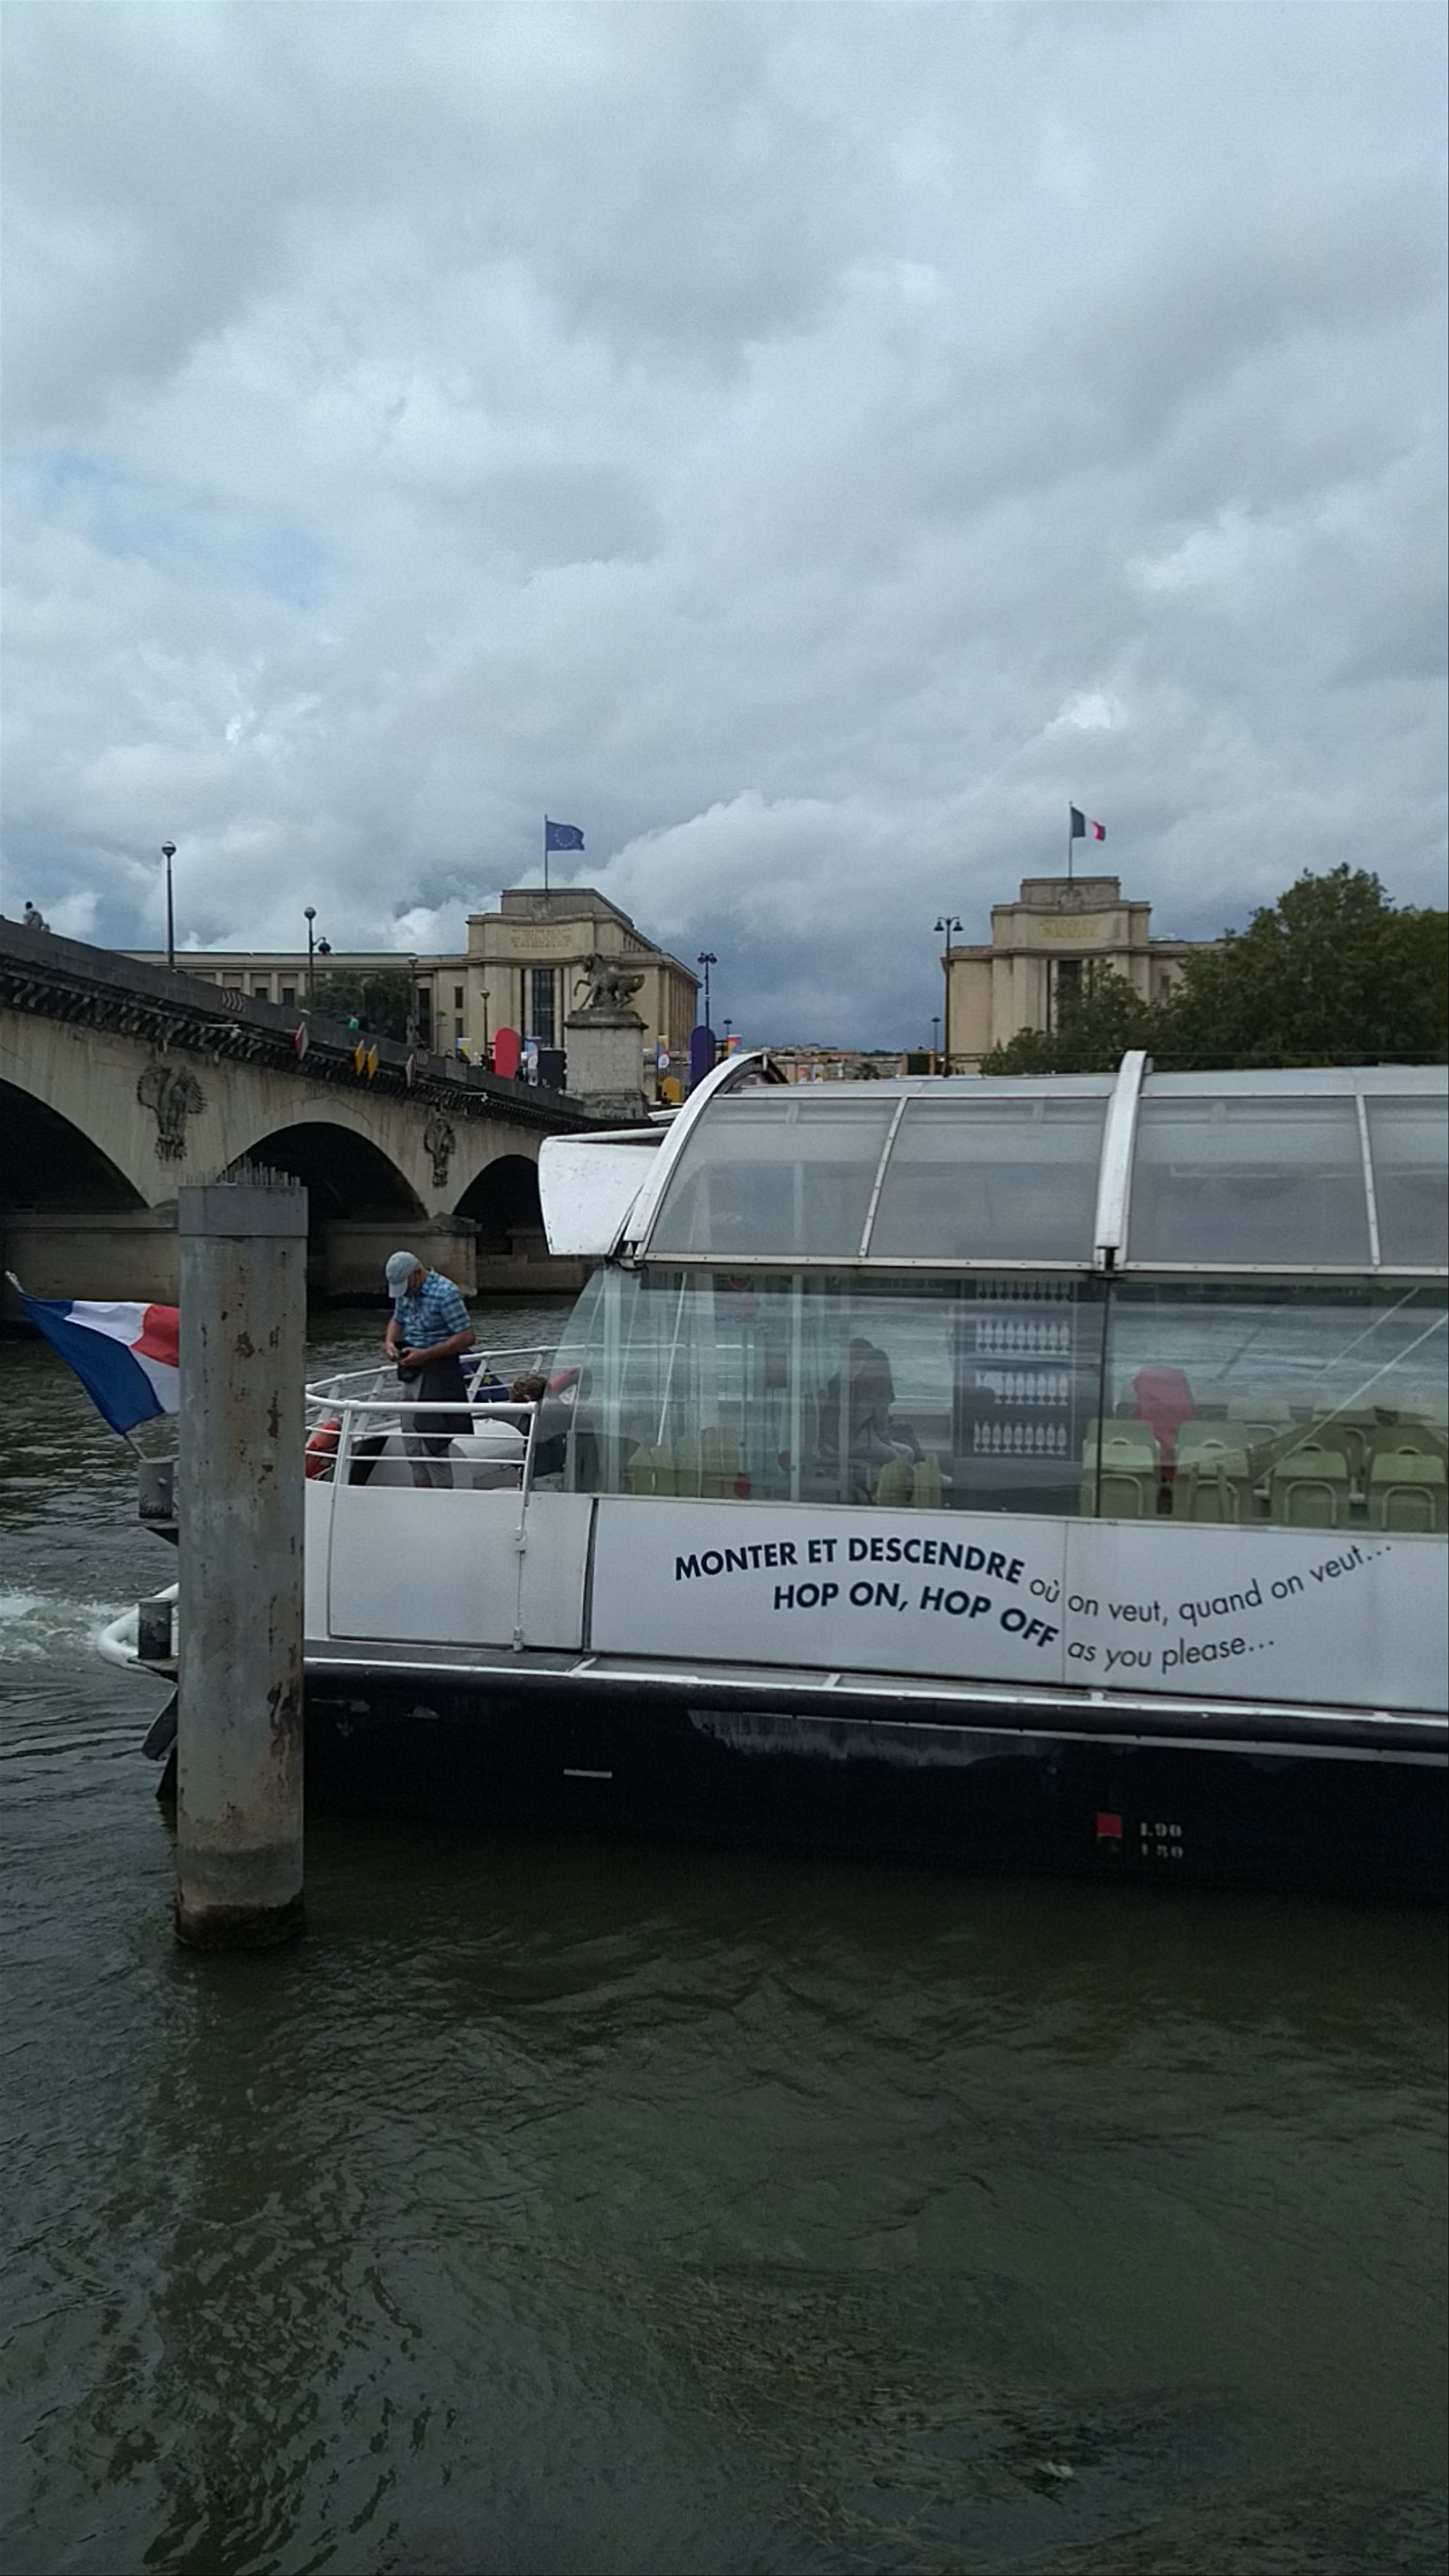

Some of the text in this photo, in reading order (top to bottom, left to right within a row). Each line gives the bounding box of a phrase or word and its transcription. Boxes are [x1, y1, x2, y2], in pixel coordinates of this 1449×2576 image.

[675, 1537, 1391, 1628] MONTER ET DESCENDRE où on veut, quand on veut...
[773, 1581, 1274, 1675] HOP ON, HOP OFF as you please...
